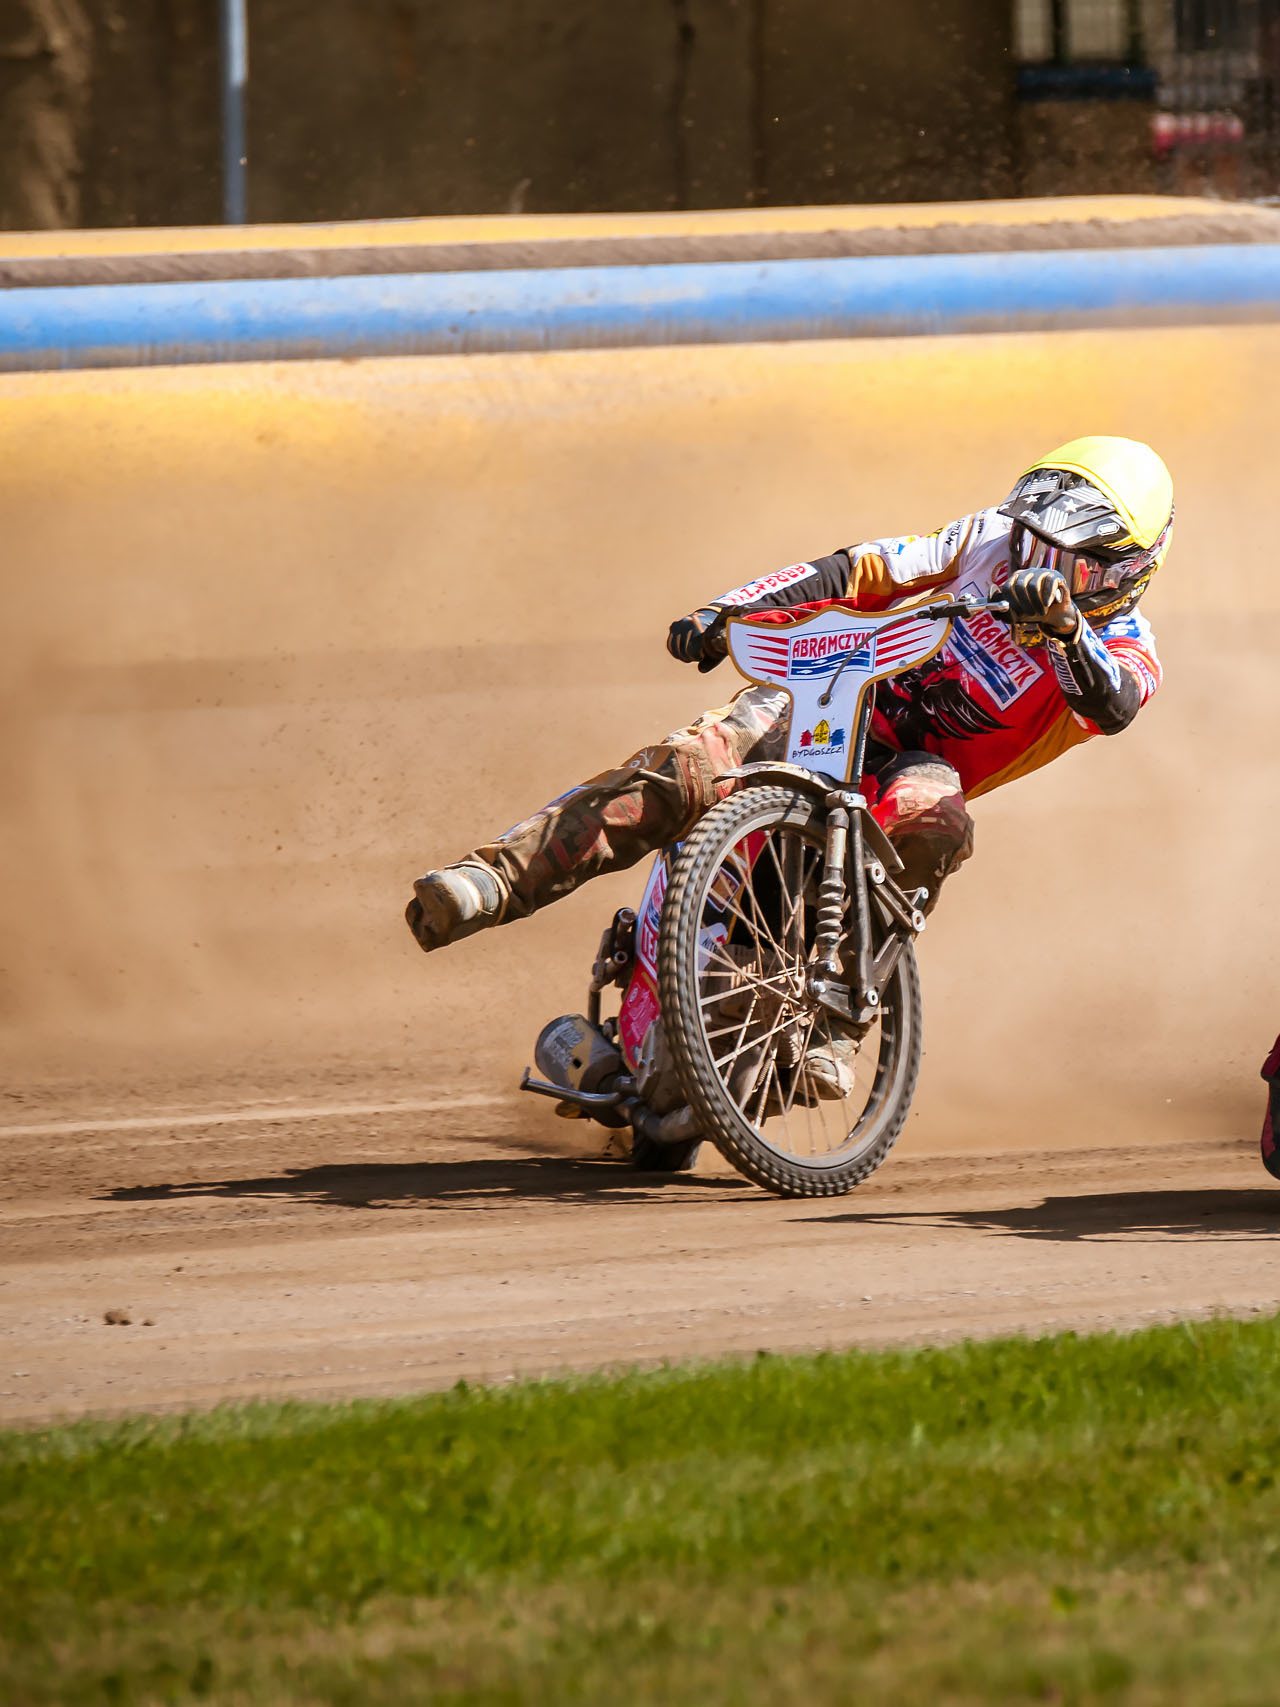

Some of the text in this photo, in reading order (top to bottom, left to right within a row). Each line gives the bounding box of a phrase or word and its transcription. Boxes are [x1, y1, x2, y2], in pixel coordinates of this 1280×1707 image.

[792, 632, 872, 659] ABRAMCZYK
[965, 609, 1037, 687] RAMCZYK
[792, 746, 843, 758] BYDGOSZCZ
